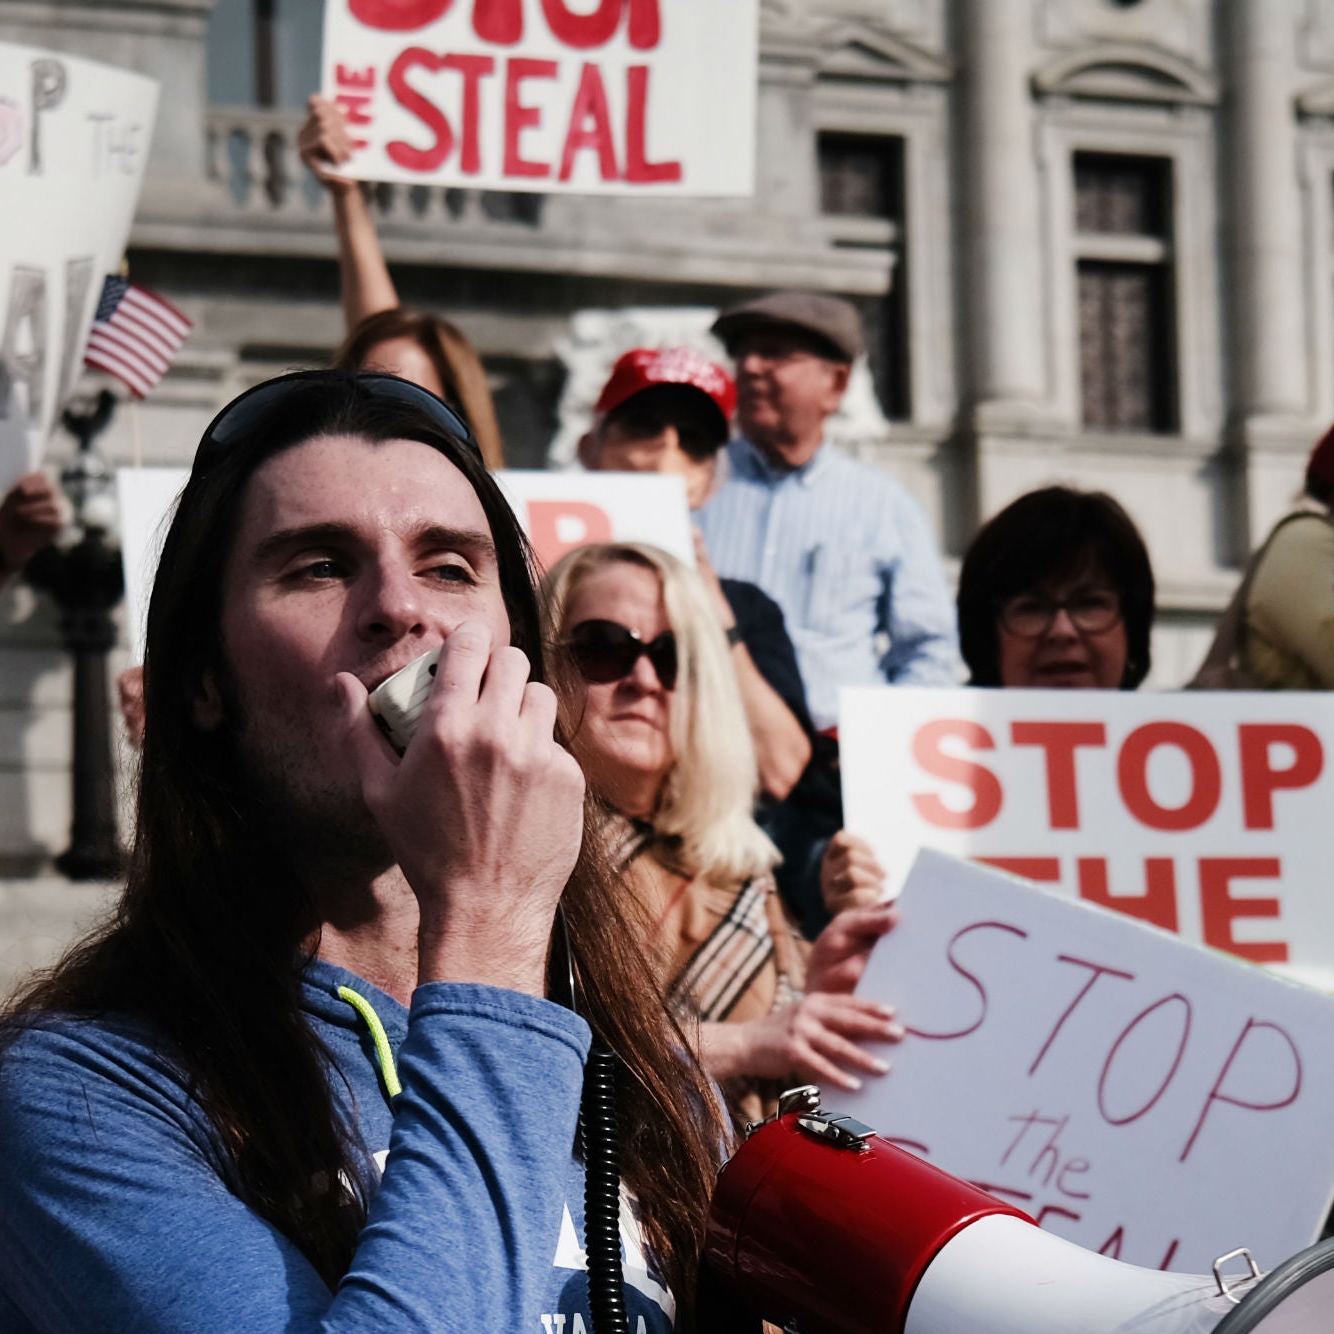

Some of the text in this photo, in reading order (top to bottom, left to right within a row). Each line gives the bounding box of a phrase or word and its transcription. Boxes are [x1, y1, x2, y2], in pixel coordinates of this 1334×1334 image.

[334, 62, 376, 152] HE
[385, 46, 682, 186] STEAL
[910, 717, 1326, 833] STOP
[905, 920, 1303, 1164] STOP
[1008, 1108, 1091, 1200] the
